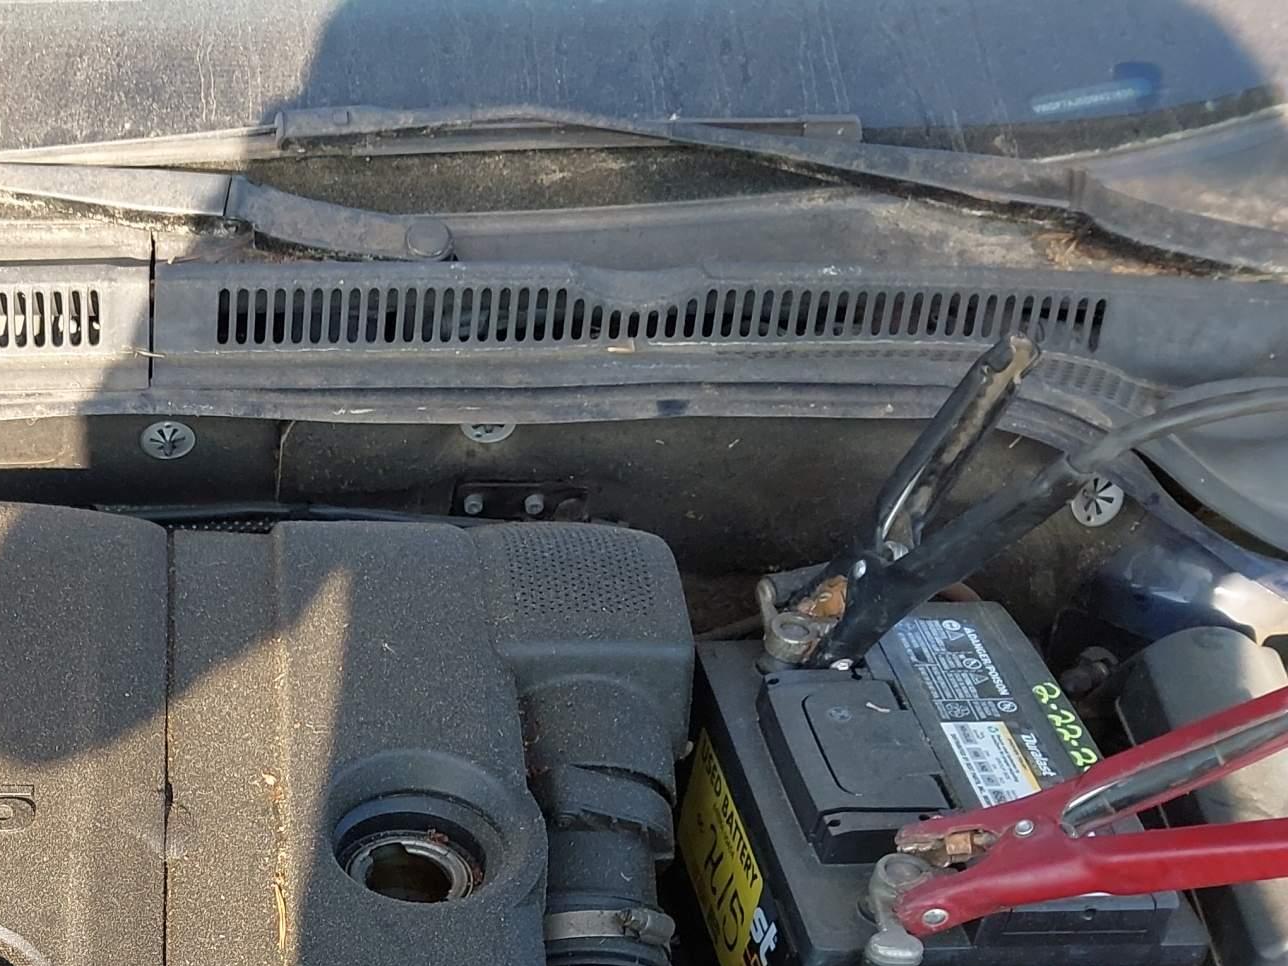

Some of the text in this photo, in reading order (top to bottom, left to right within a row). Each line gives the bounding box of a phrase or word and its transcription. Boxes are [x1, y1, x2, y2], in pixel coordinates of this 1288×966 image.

[1020, 732, 1057, 777] Duralast
[701, 744, 722, 797] USED
[721, 795, 759, 889] BATTERY
